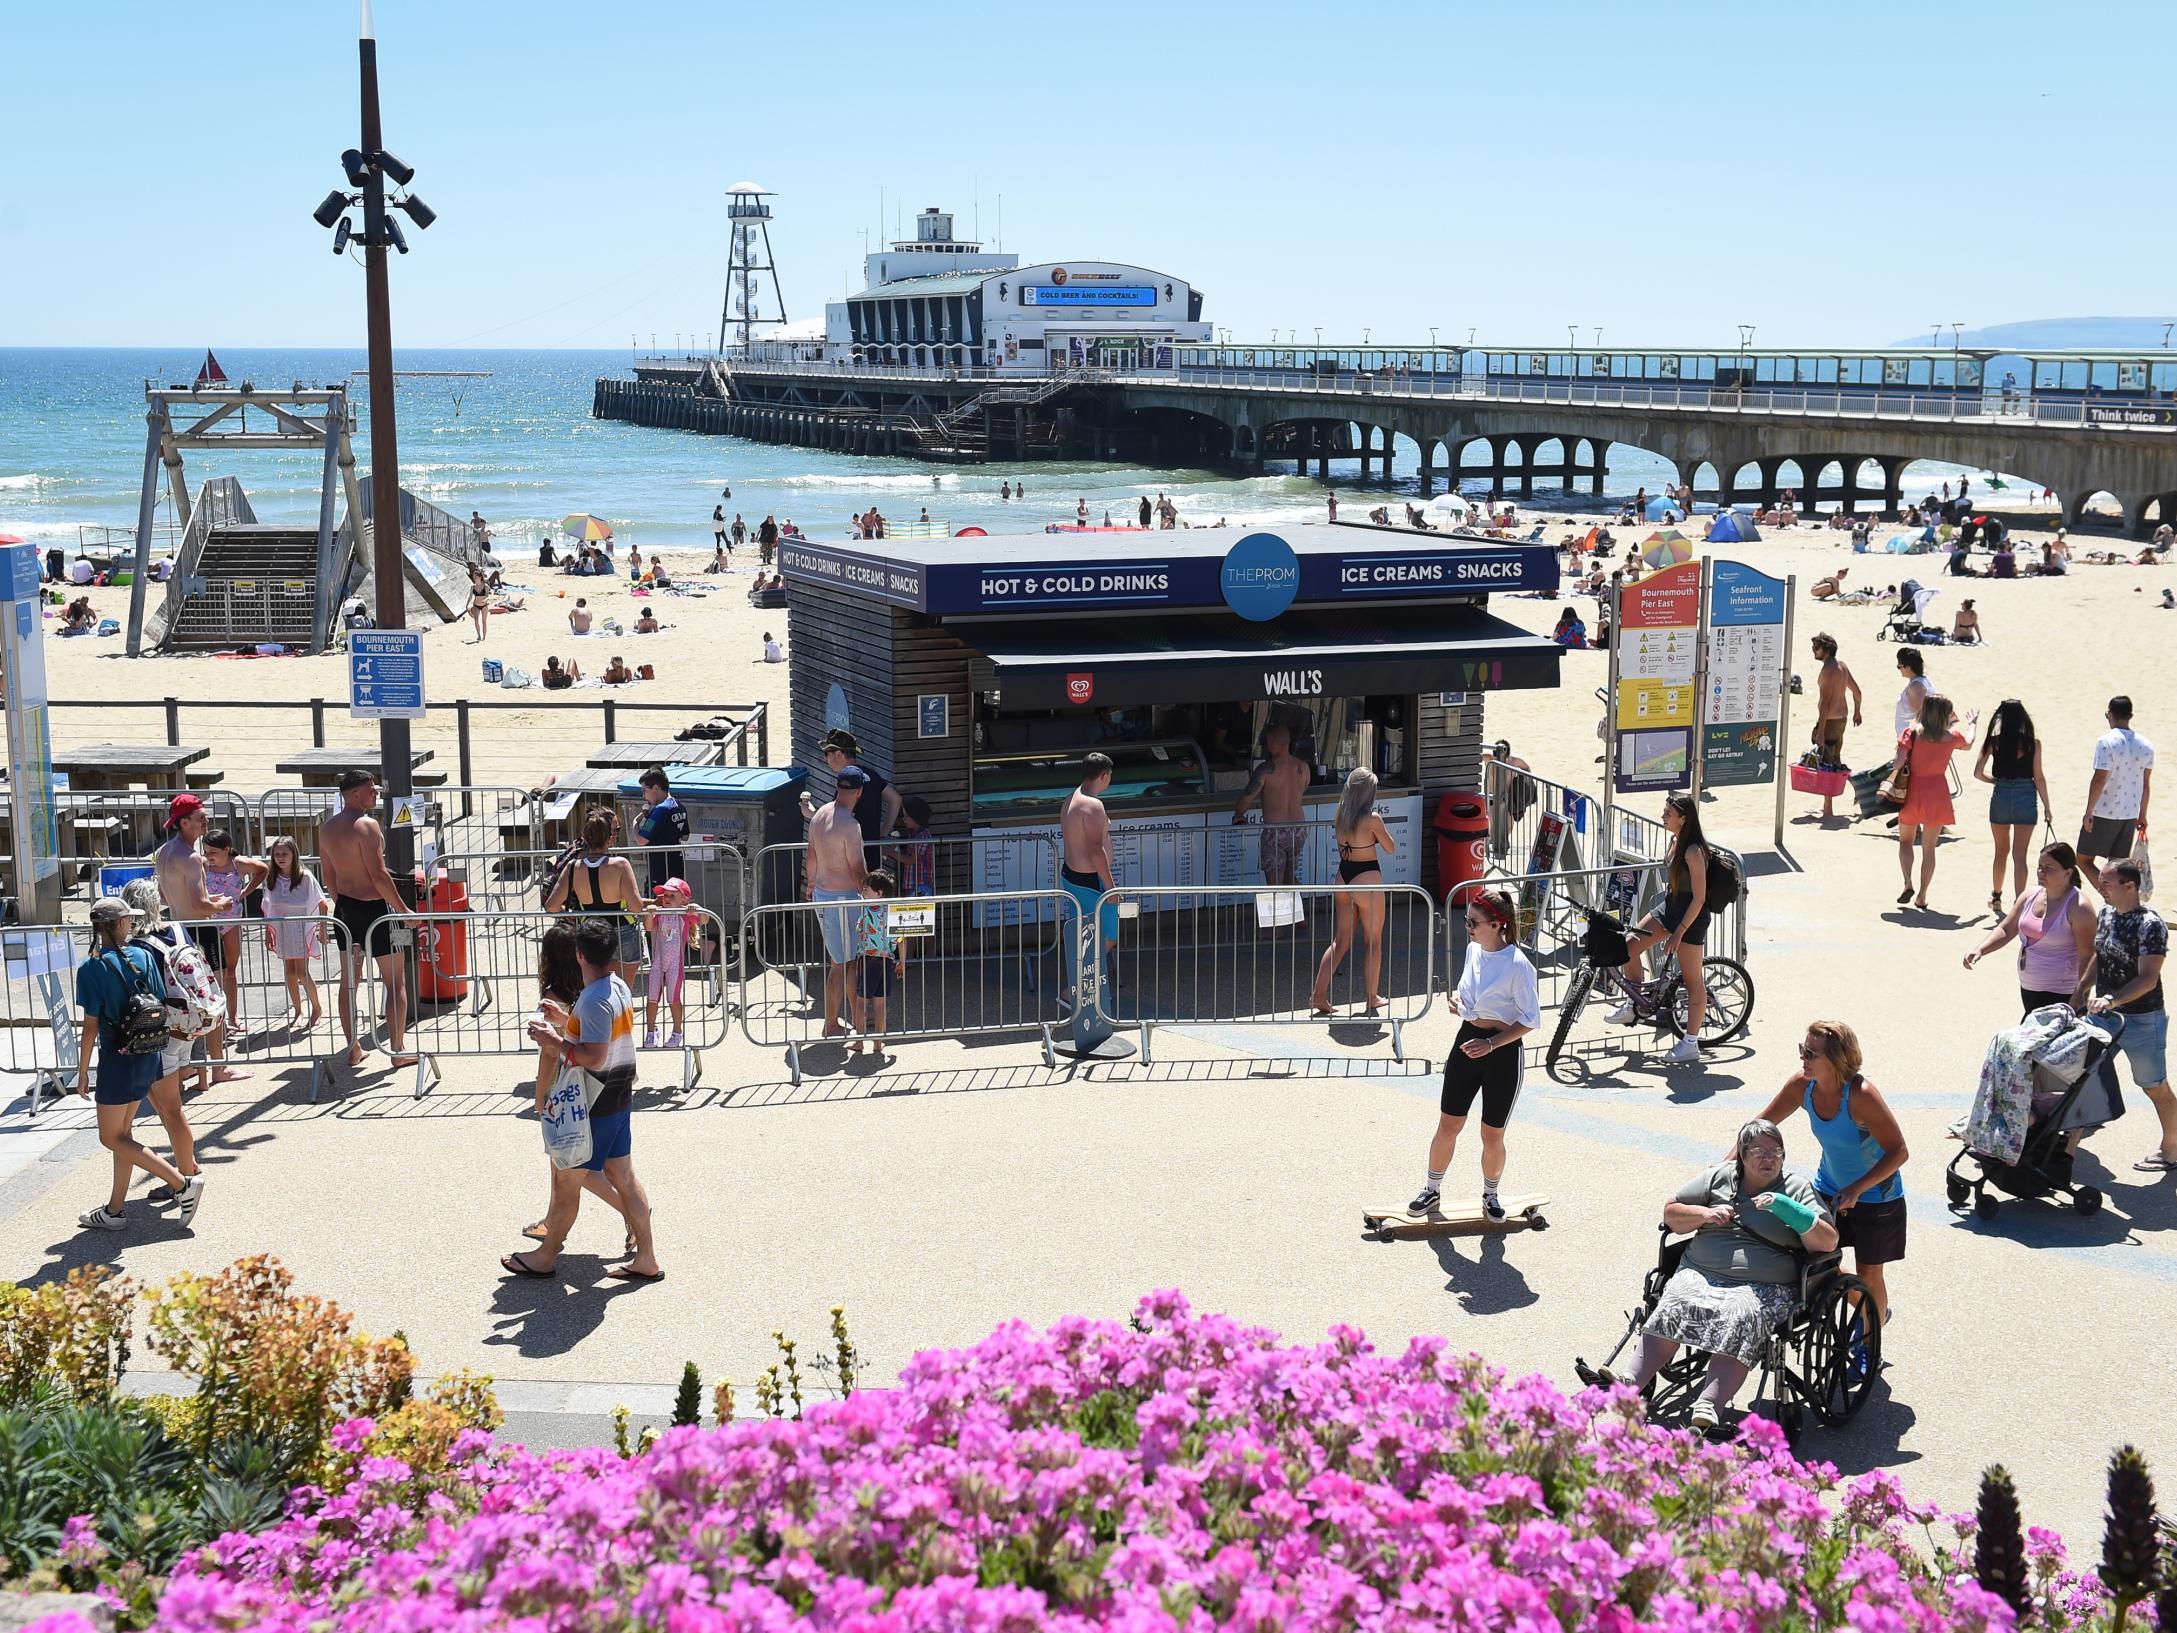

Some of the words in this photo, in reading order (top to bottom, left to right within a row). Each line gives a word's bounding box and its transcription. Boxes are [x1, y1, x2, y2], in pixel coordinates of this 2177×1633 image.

[2091, 408, 2122, 422] Think
[2124, 410, 2156, 423] twice
[782, 551, 794, 566] HOT
[795, 553, 800, 567] &
[800, 554, 817, 571] COLD
[818, 558, 841, 576] DRINKS
[845, 563, 857, 580] ICE
[857, 567, 885, 586] CREAMS
[890, 574, 919, 595] SNACKS
[1341, 567, 1369, 583] ICE
[1373, 565, 1443, 582] CREAMS
[1456, 562, 1523, 579] SNACKS
[981, 579, 1020, 595] HOT
[1024, 578, 1038, 594] &
[1042, 576, 1095, 593] COLD
[1100, 574, 1169, 591] DRINKS
[1730, 585, 1762, 594] Seafront
[1641, 587, 1694, 597] Bournemouth
[1641, 600, 1656, 608] Pier
[1657, 599, 1674, 608] East
[1730, 596, 1774, 605] Information
[356, 635, 415, 644] BOURNEMOUTH
[366, 644, 384, 652] PIER
[385, 644, 405, 653] EAST
[1264, 669, 1322, 696] WALL'S
[570, 1102, 589, 1123] Hel
